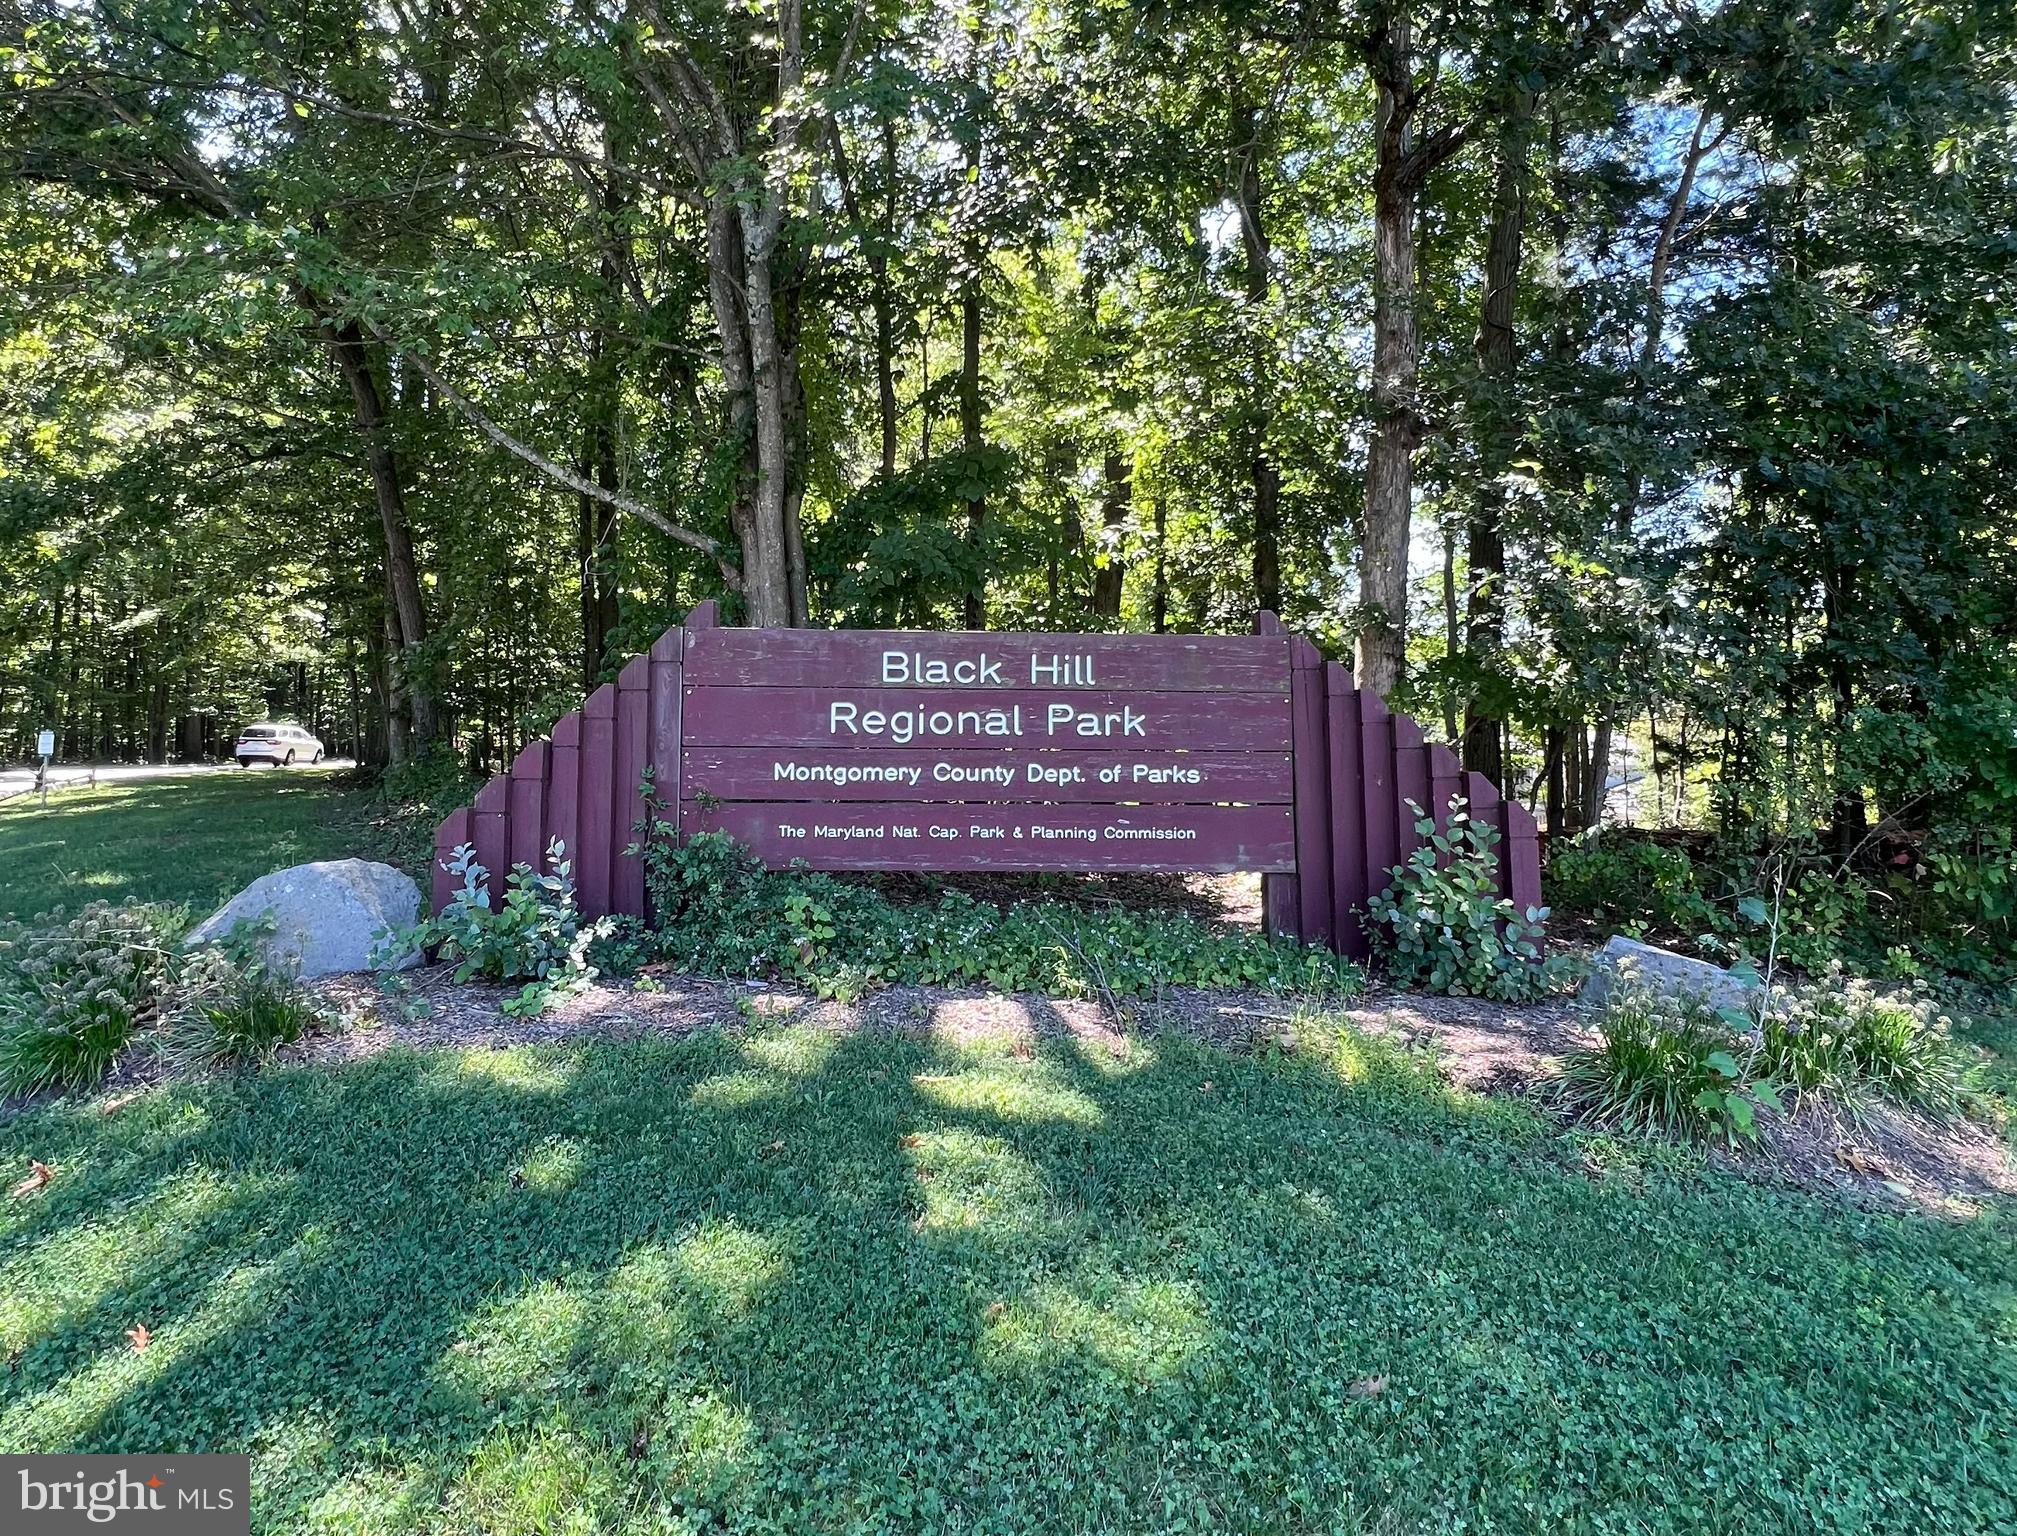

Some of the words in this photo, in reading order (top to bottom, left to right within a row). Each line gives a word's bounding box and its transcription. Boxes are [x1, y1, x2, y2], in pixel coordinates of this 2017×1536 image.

[881, 651, 1002, 685] Black
[1029, 653, 1096, 687] Hill
[829, 701, 1023, 743] Regional
[1047, 703, 1146, 737] Park
[773, 762, 922, 786] Montgomery
[933, 763, 1016, 787] County
[1027, 764, 1086, 786] Dept.
[1098, 764, 1122, 784] of
[778, 825, 806, 839] The
[813, 825, 884, 842] Maryland
[892, 826, 921, 839] Nat.
[928, 826, 962, 841] Cap.
[969, 826, 1004, 840] Park
[1012, 826, 1023, 840] &
[1030, 826, 1097, 843] Planning
[1104, 826, 1196, 840] Commission
